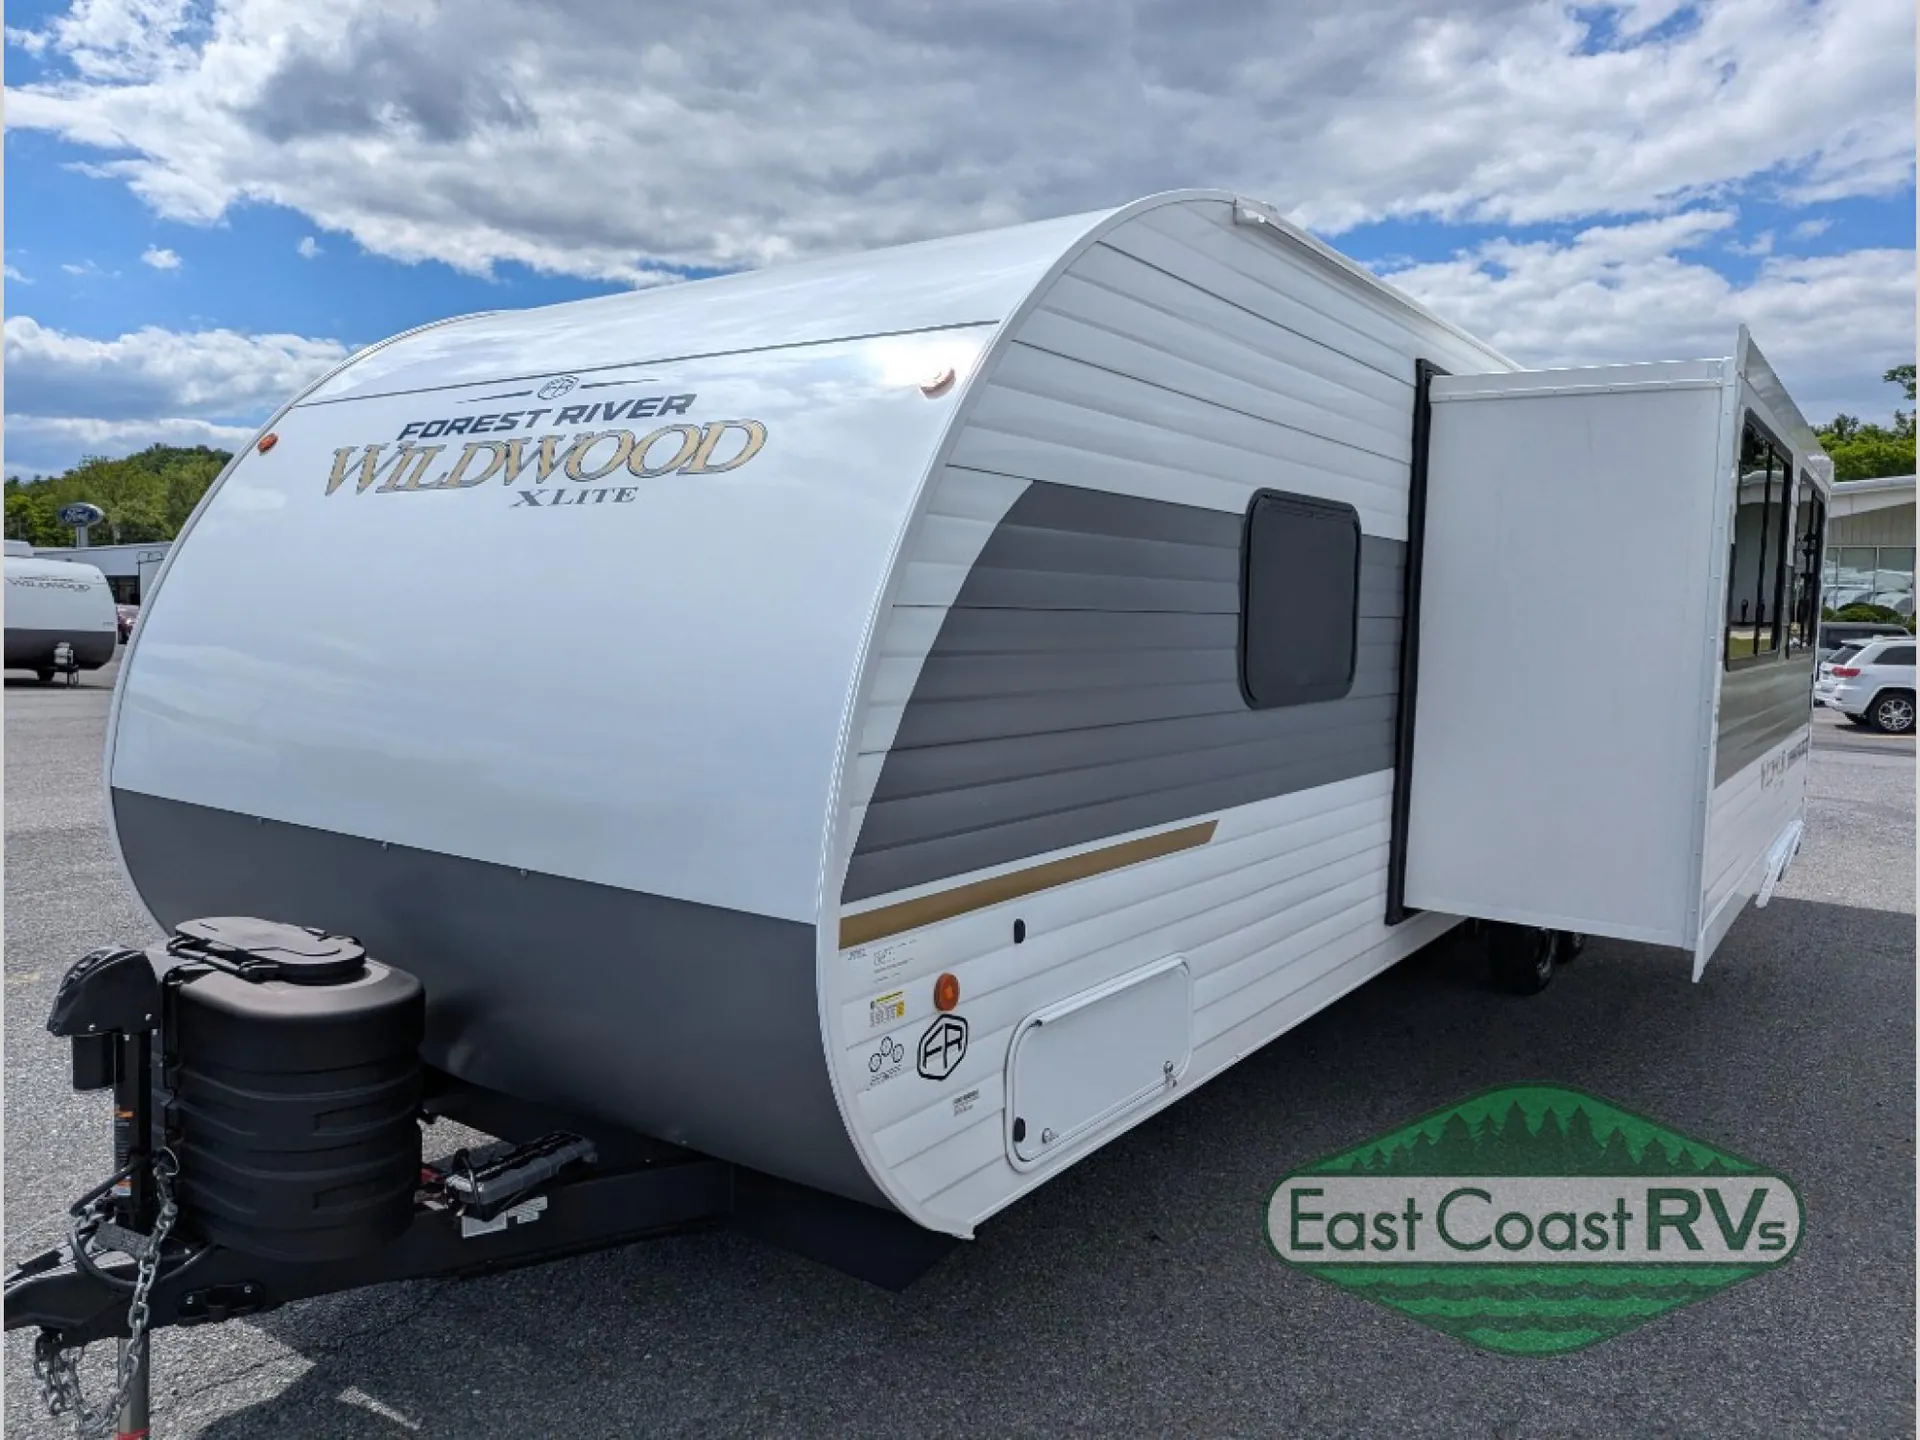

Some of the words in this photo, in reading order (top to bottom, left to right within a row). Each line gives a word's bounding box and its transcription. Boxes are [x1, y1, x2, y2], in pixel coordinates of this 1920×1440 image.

[396, 409, 552, 442] FOREST
[552, 393, 697, 426] RIVER
[324, 419, 768, 496] WILDWOOD
